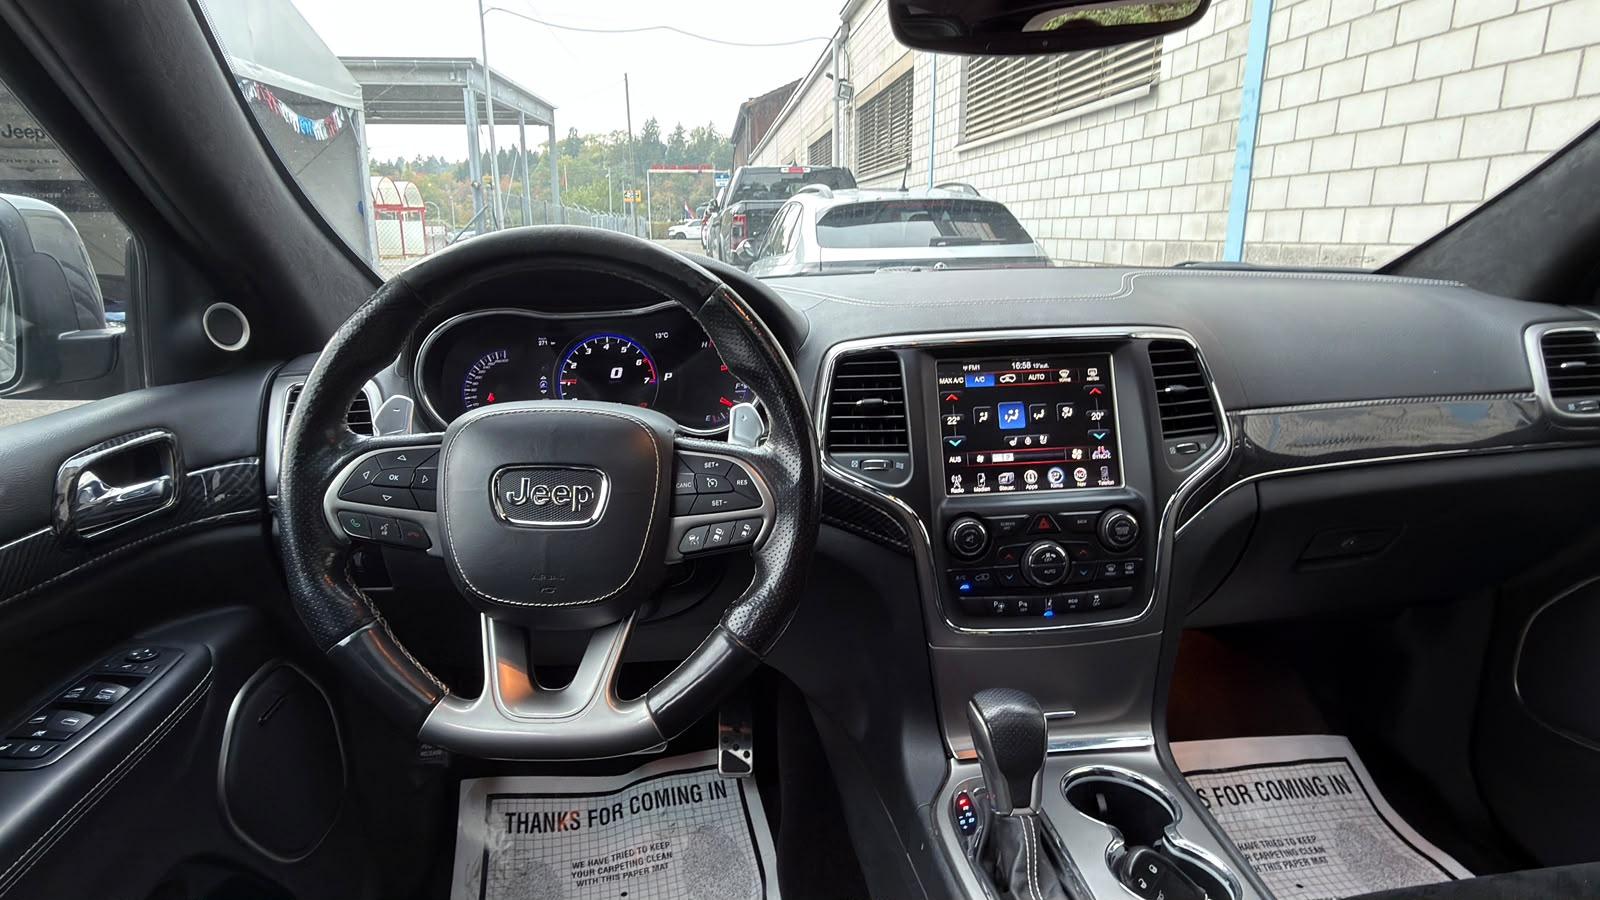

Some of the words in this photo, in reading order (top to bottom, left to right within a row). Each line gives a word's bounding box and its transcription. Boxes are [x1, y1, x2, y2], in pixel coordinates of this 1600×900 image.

[1, 123, 45, 142] Jeep
[1011, 362, 1031, 370] 16:58
[664, 373, 673, 381] P
[1028, 373, 1045, 381] AUTO
[947, 416, 960, 425] 22°
[1091, 411, 1105, 421] 20°
[704, 461, 719, 469] SET+
[948, 455, 962, 463] AUS
[675, 481, 692, 489] CANC
[506, 477, 595, 513] Jeep
[1212, 784, 1255, 807] FOR
[1254, 776, 1330, 802] COMING
[1327, 774, 1352, 796] IN
[504, 811, 581, 834] THANKS
[588, 803, 624, 828] FOR
[628, 783, 704, 816] COMING
[708, 780, 728, 800] IN
[1236, 841, 1259, 851] HAVE
[1259, 838, 1284, 849] TRIED
[1284, 838, 1297, 846] TO
[1296, 835, 1317, 845] KEEP
[572, 861, 585, 870] WE
[587, 856, 609, 867] HAVE
[611, 848, 636, 862] TRIED
[637, 845, 648, 854] TO
[650, 841, 671, 851] KEEP
[1252, 848, 1299, 862] CARPETING
[1299, 846, 1327, 856] CLEAN
[571, 870, 595, 879] YOUR
[597, 857, 645, 875] CARPETING
[646, 851, 673, 864] CLEAN
[1262, 861, 1282, 872] THIS
[1282, 858, 1310, 869] PAPER
[576, 878, 599, 887] WITH
[602, 873, 620, 883] THIS
[623, 867, 650, 879] PAPER
[652, 862, 670, 873] MAT
